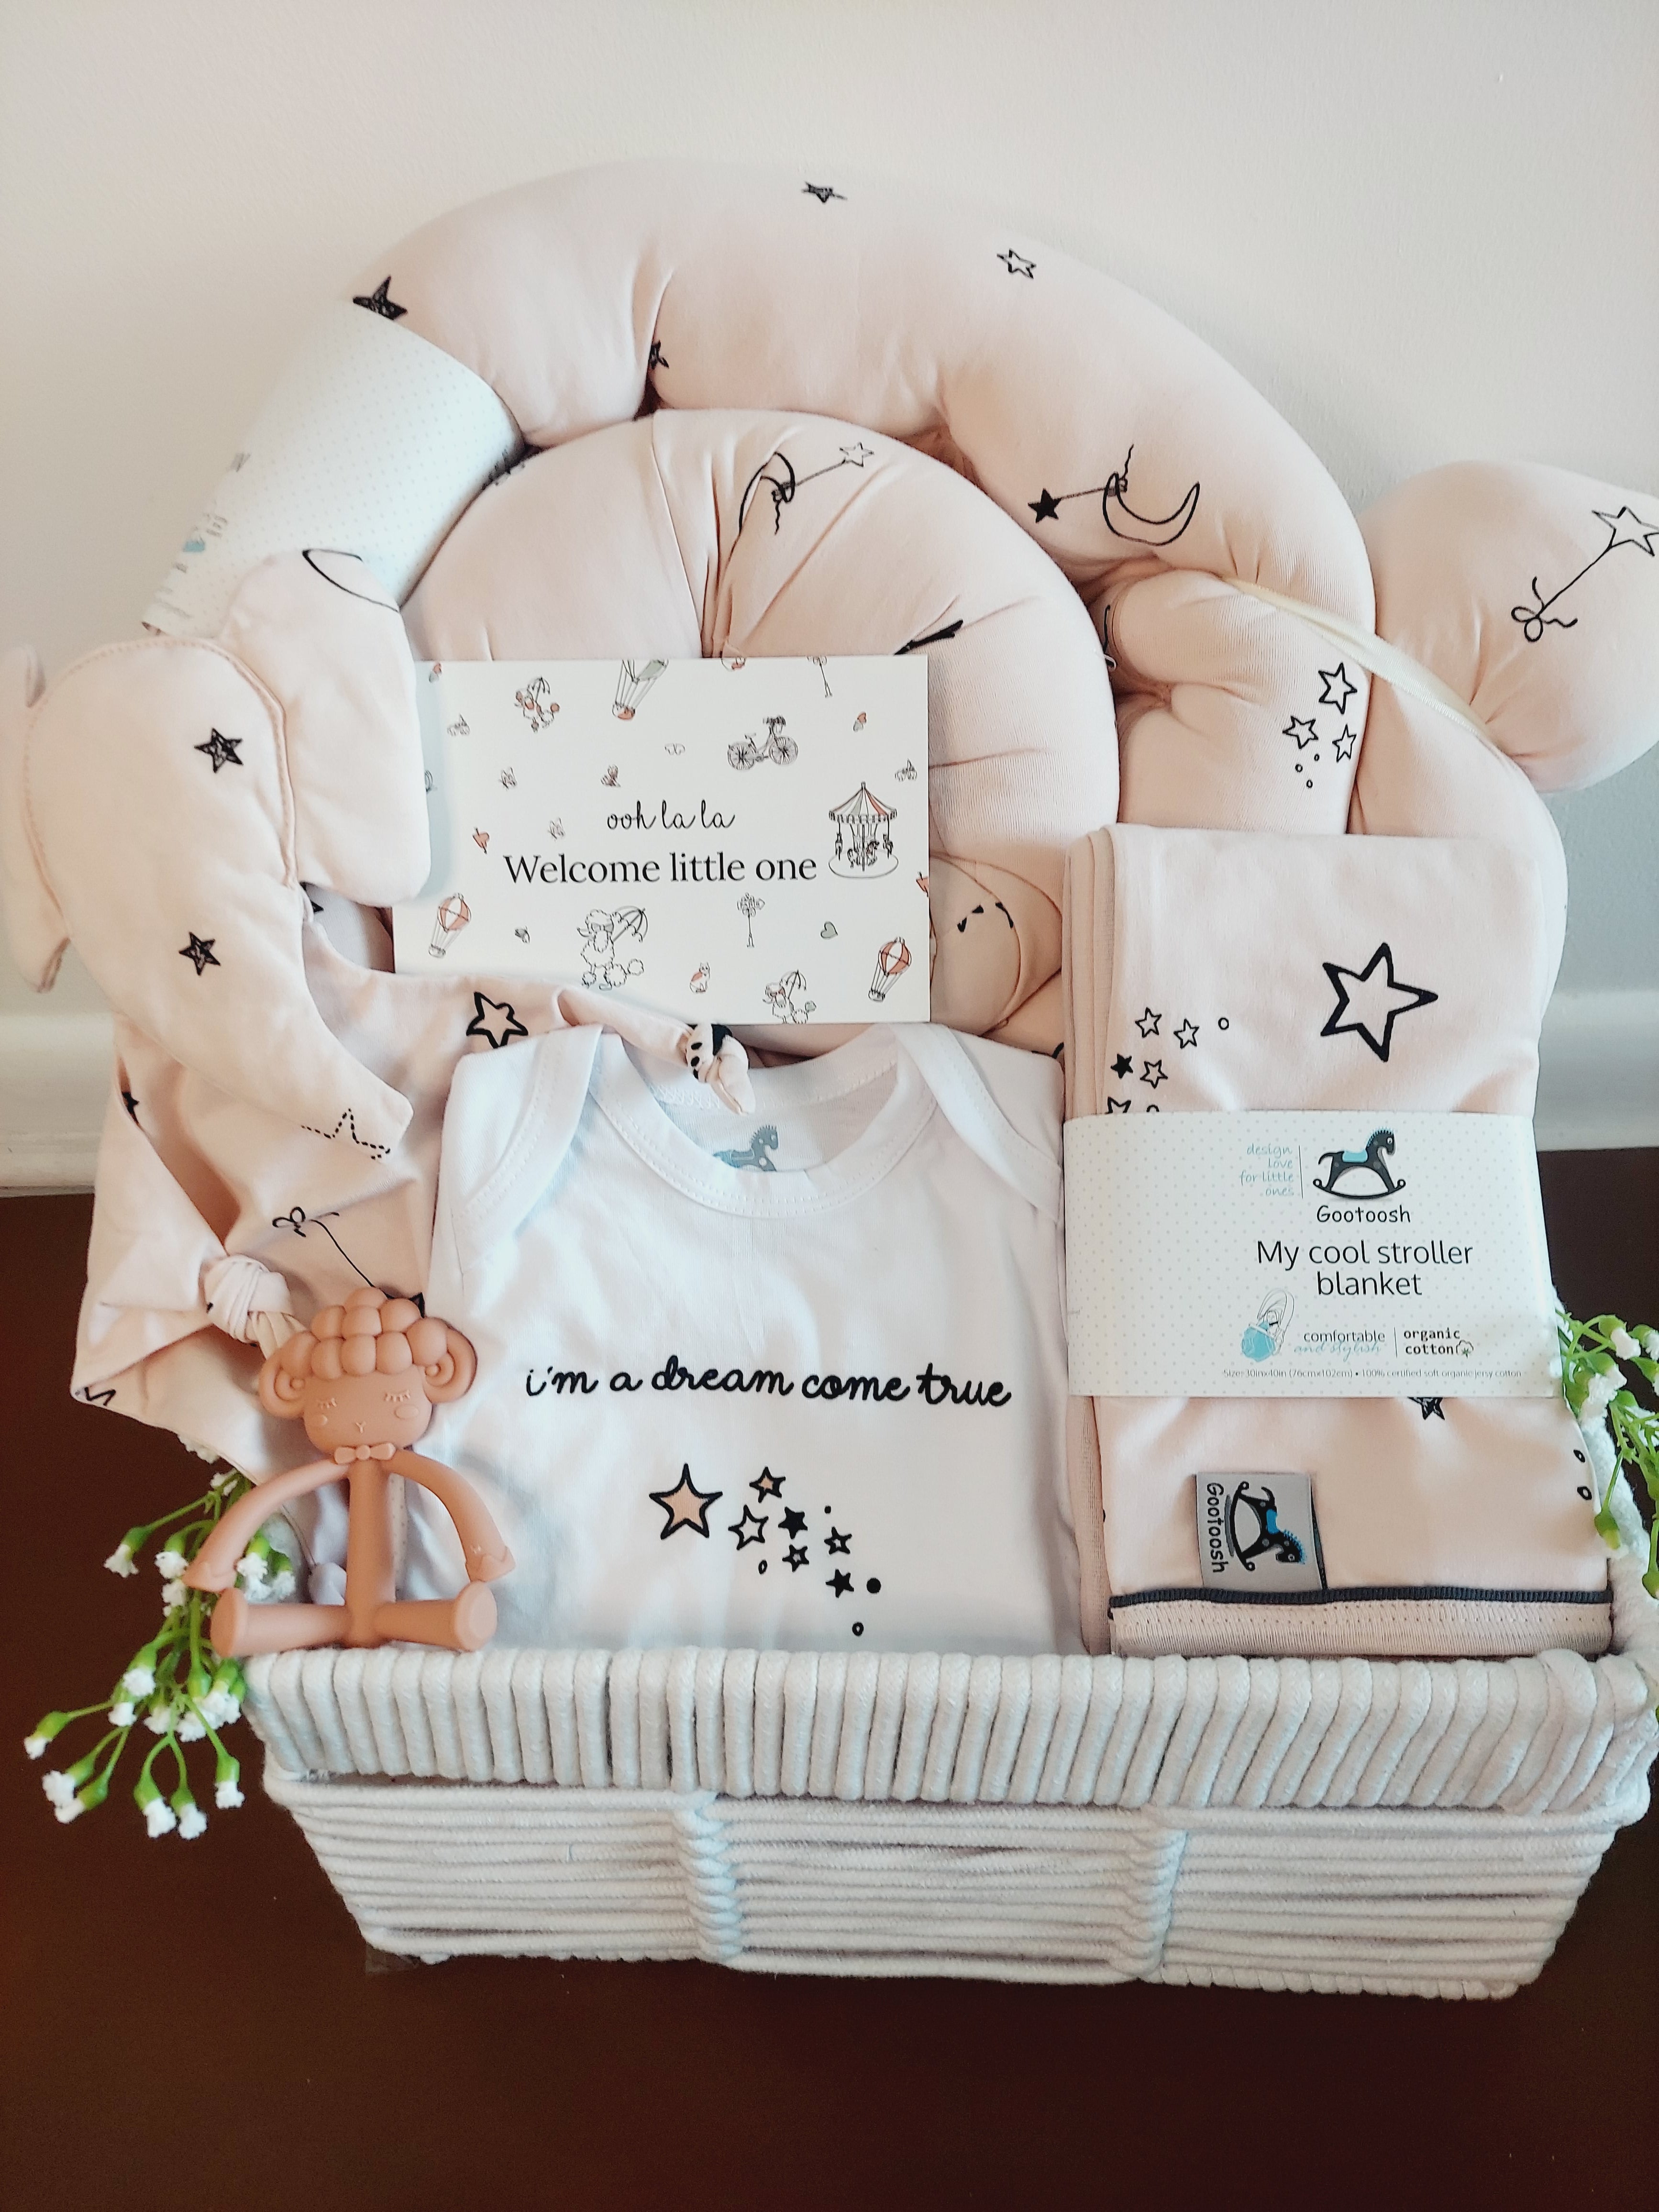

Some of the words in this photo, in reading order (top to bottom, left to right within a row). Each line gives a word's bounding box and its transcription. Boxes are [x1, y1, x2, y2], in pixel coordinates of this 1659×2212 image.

[607, 799, 657, 830] ooh
[661, 799, 696, 830] la
[700, 799, 735, 830] la
[503, 854, 660, 884] Welcome
[670, 852, 745, 882] little
[756, 857, 818, 881] one
[1247, 1143, 1293, 1159] design
[1268, 1157, 1293, 1169] love
[1239, 1169, 1257, 1186] for
[1262, 1170, 1294, 1182] little
[1316, 1205, 1411, 1224] Gootoosh
[1257, 1240, 1299, 1271] My
[1309, 1240, 1370, 1265] cool
[1378, 1240, 1474, 1265] stroller
[1316, 1271, 1422, 1296] blanket
[1304, 1329, 1385, 1343] comfortable
[1403, 1327, 1461, 1341] organic
[1405, 1343, 1454, 1355] cotton
[525, 1366, 598, 1396] i'm
[609, 1371, 643, 1393] a
[651, 1355, 795, 1396] dream
[801, 1371, 910, 1401] come
[916, 1363, 1012, 1406] true
[1206, 1482, 1229, 1573] Gootoosh
